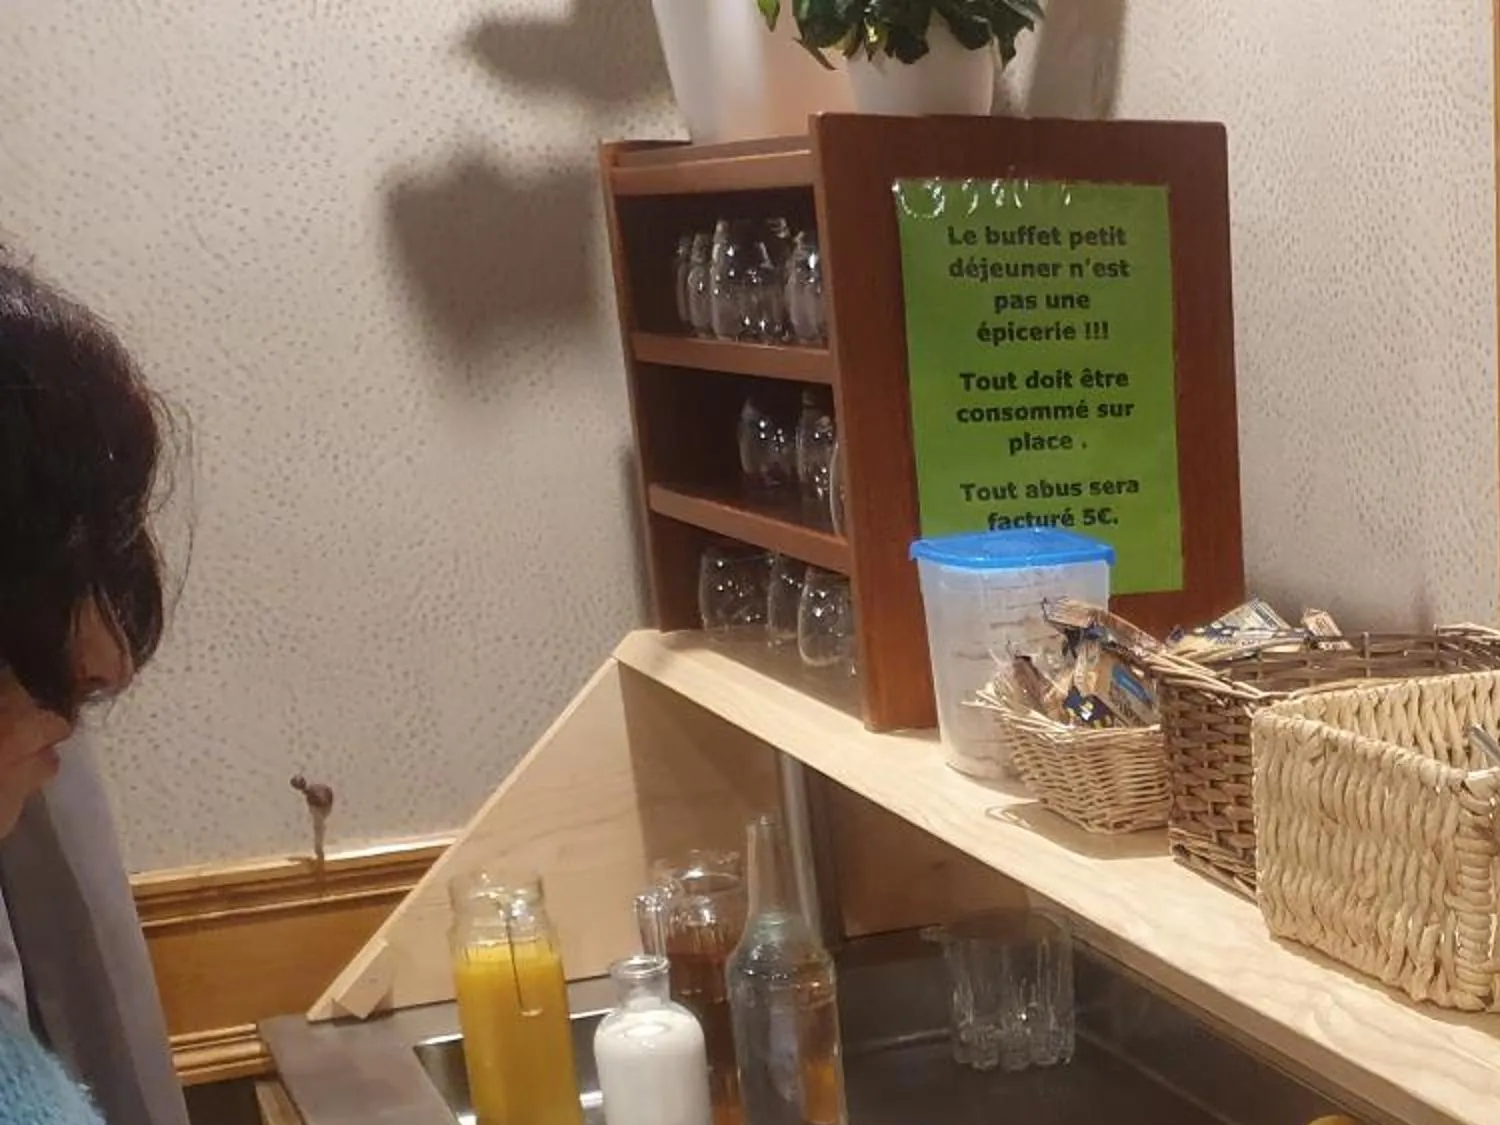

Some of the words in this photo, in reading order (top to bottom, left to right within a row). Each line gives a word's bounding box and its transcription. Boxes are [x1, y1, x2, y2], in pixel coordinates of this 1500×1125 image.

[947, 226, 977, 247] Le
[985, 226, 1061, 247] buffet
[1069, 226, 1126, 251] petit
[949, 257, 1062, 283] déjeuner
[1069, 260, 1131, 279] n'est
[994, 294, 1037, 315] pas
[1045, 292, 1090, 310] une
[976, 320, 1076, 346] épicerie
[1085, 321, 1109, 340] !!!
[959, 371, 1017, 392] Tout
[1025, 369, 1073, 389] doit
[1080, 367, 1129, 388] être
[956, 400, 1089, 423] consommé
[1096, 401, 1135, 419] sur
[1008, 432, 1073, 455] place
[960, 482, 1017, 502] Tout
[1025, 480, 1083, 499] abus
[1089, 478, 1140, 497] sera
[987, 507, 1075, 531] facturé
[1082, 508, 1119, 527] 5€.
